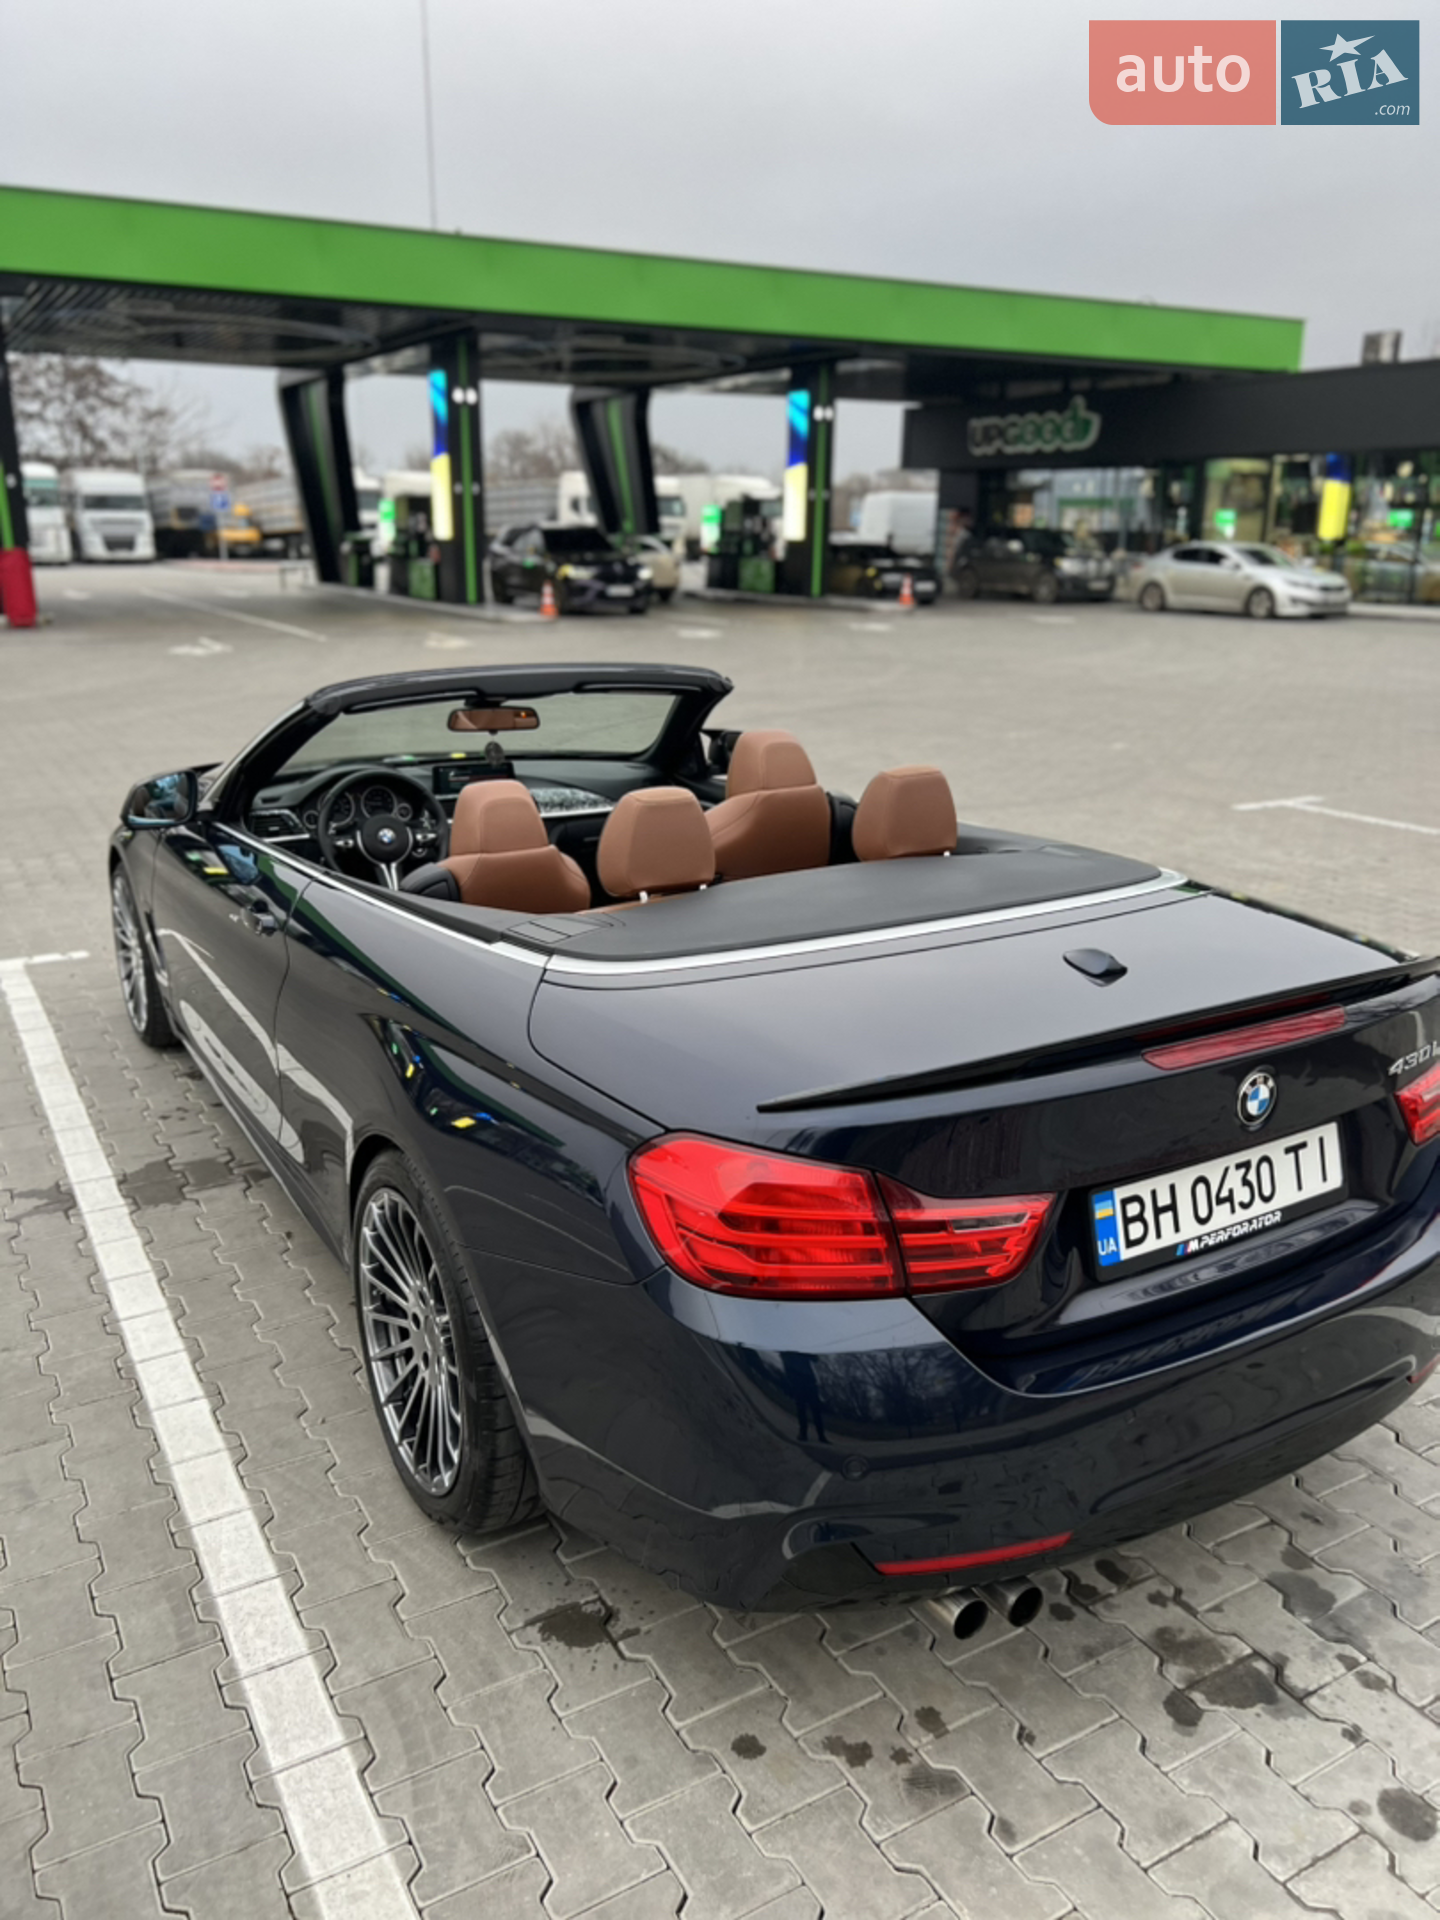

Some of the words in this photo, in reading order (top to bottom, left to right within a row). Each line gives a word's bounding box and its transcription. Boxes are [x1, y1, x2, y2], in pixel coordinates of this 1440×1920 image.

[1120, 1182, 1180, 1251] BH
[1190, 1154, 1276, 1226] 0430
[1284, 1136, 1327, 1193] TI
[1098, 1237, 1118, 1256] UA
